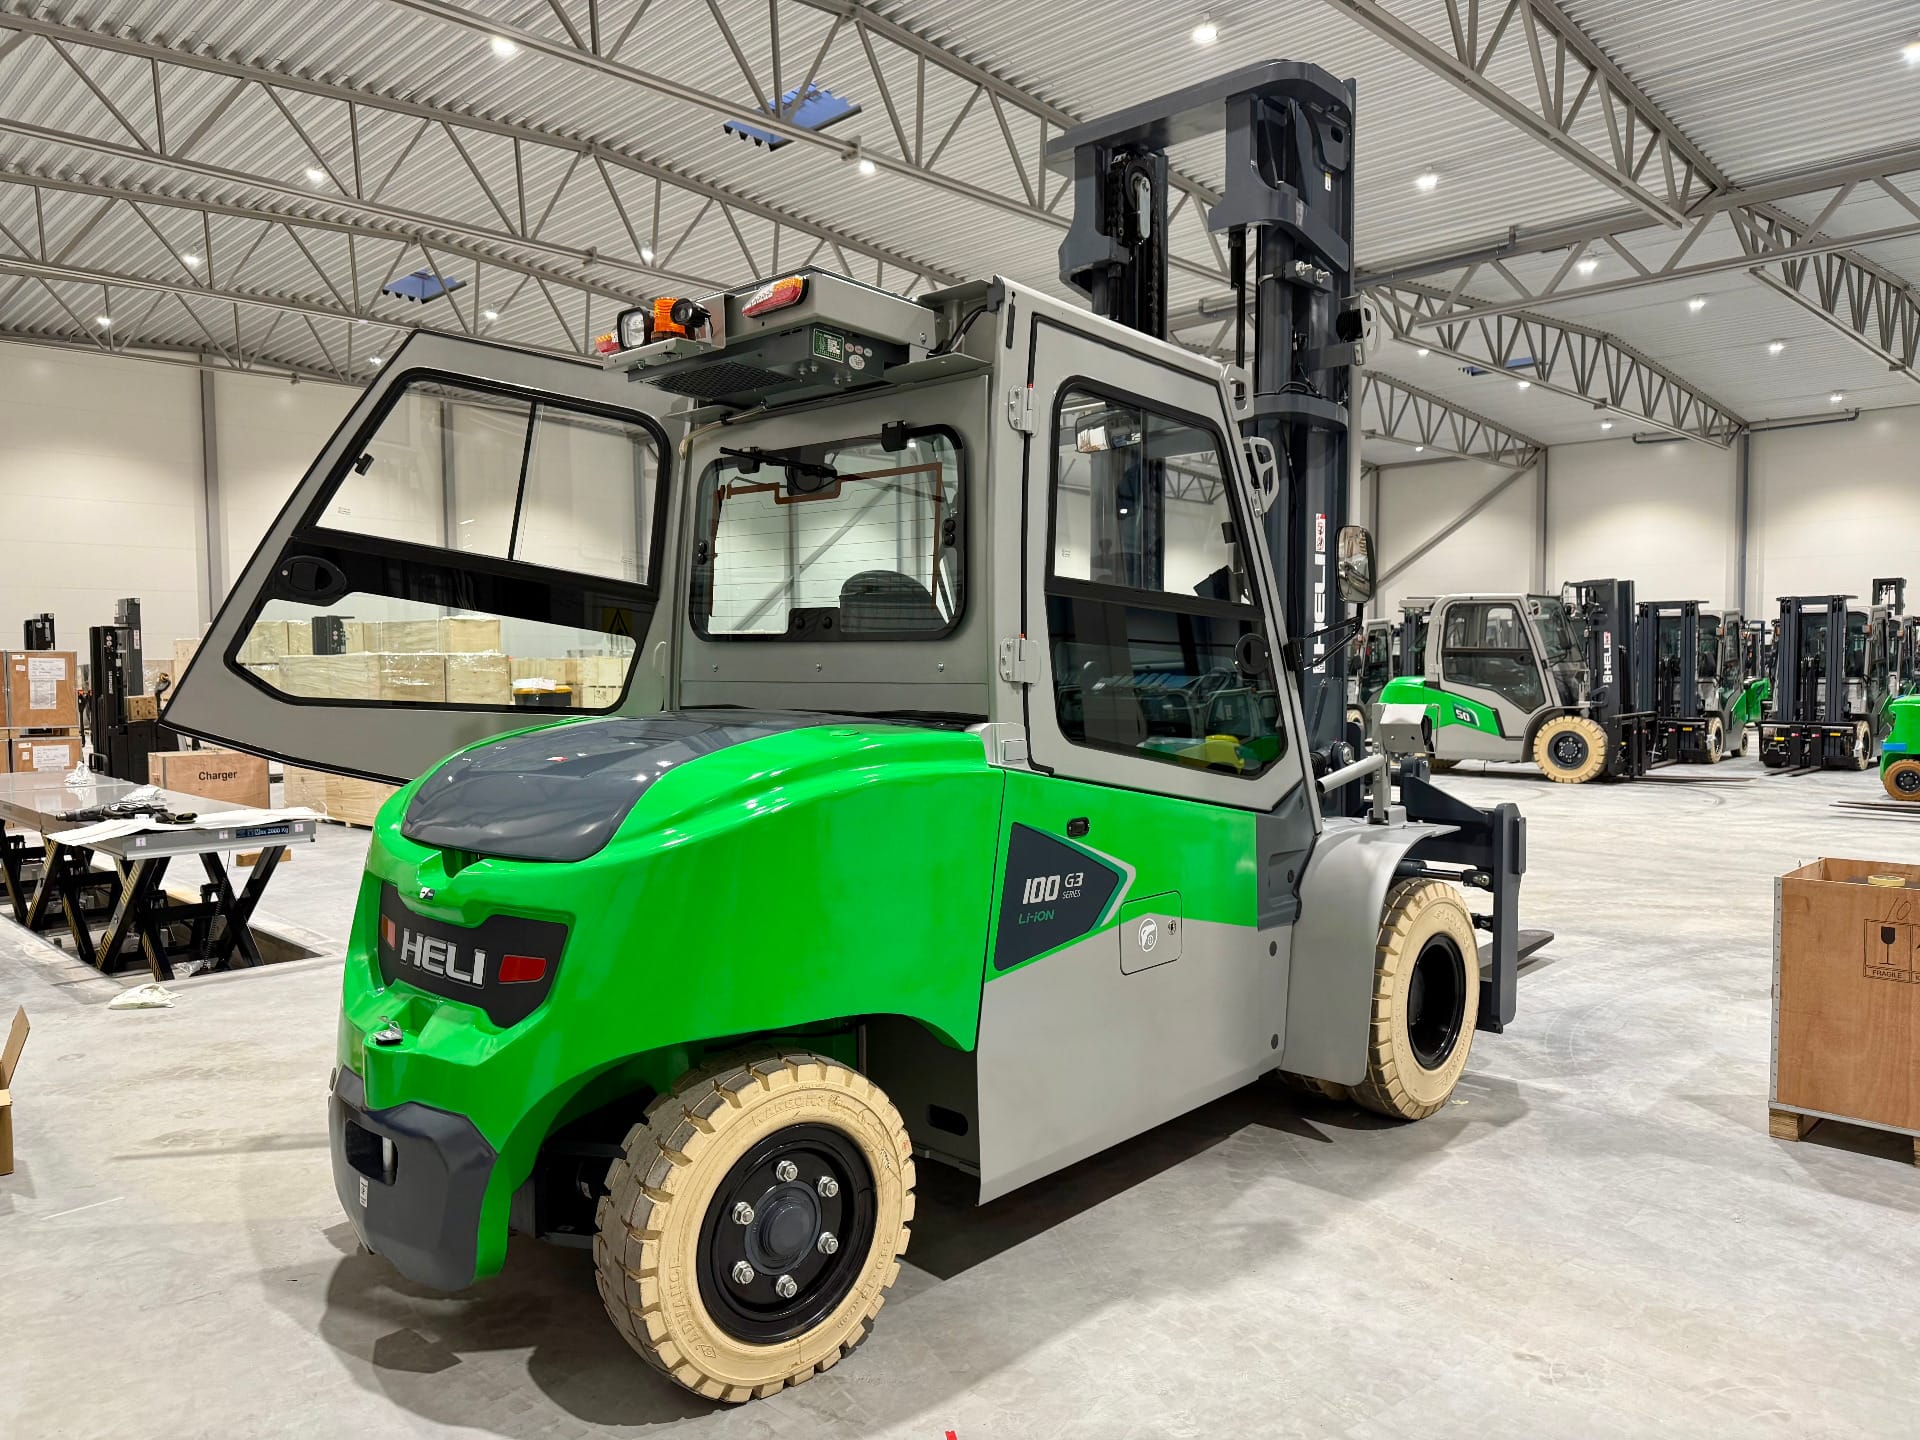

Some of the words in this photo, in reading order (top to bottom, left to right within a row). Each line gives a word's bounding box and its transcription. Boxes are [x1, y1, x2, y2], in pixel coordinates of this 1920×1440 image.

[1313, 553, 1326, 655] HELI
[1455, 709, 1471, 721] 50
[198, 771, 238, 781] Charger
[1023, 875, 1060, 904] 100
[1065, 872, 1083, 887] G3
[1062, 890, 1081, 899] SERIES
[1886, 897, 1912, 920] 10
[400, 928, 486, 988] HELI
[1872, 970, 1902, 979] FRAGILE
